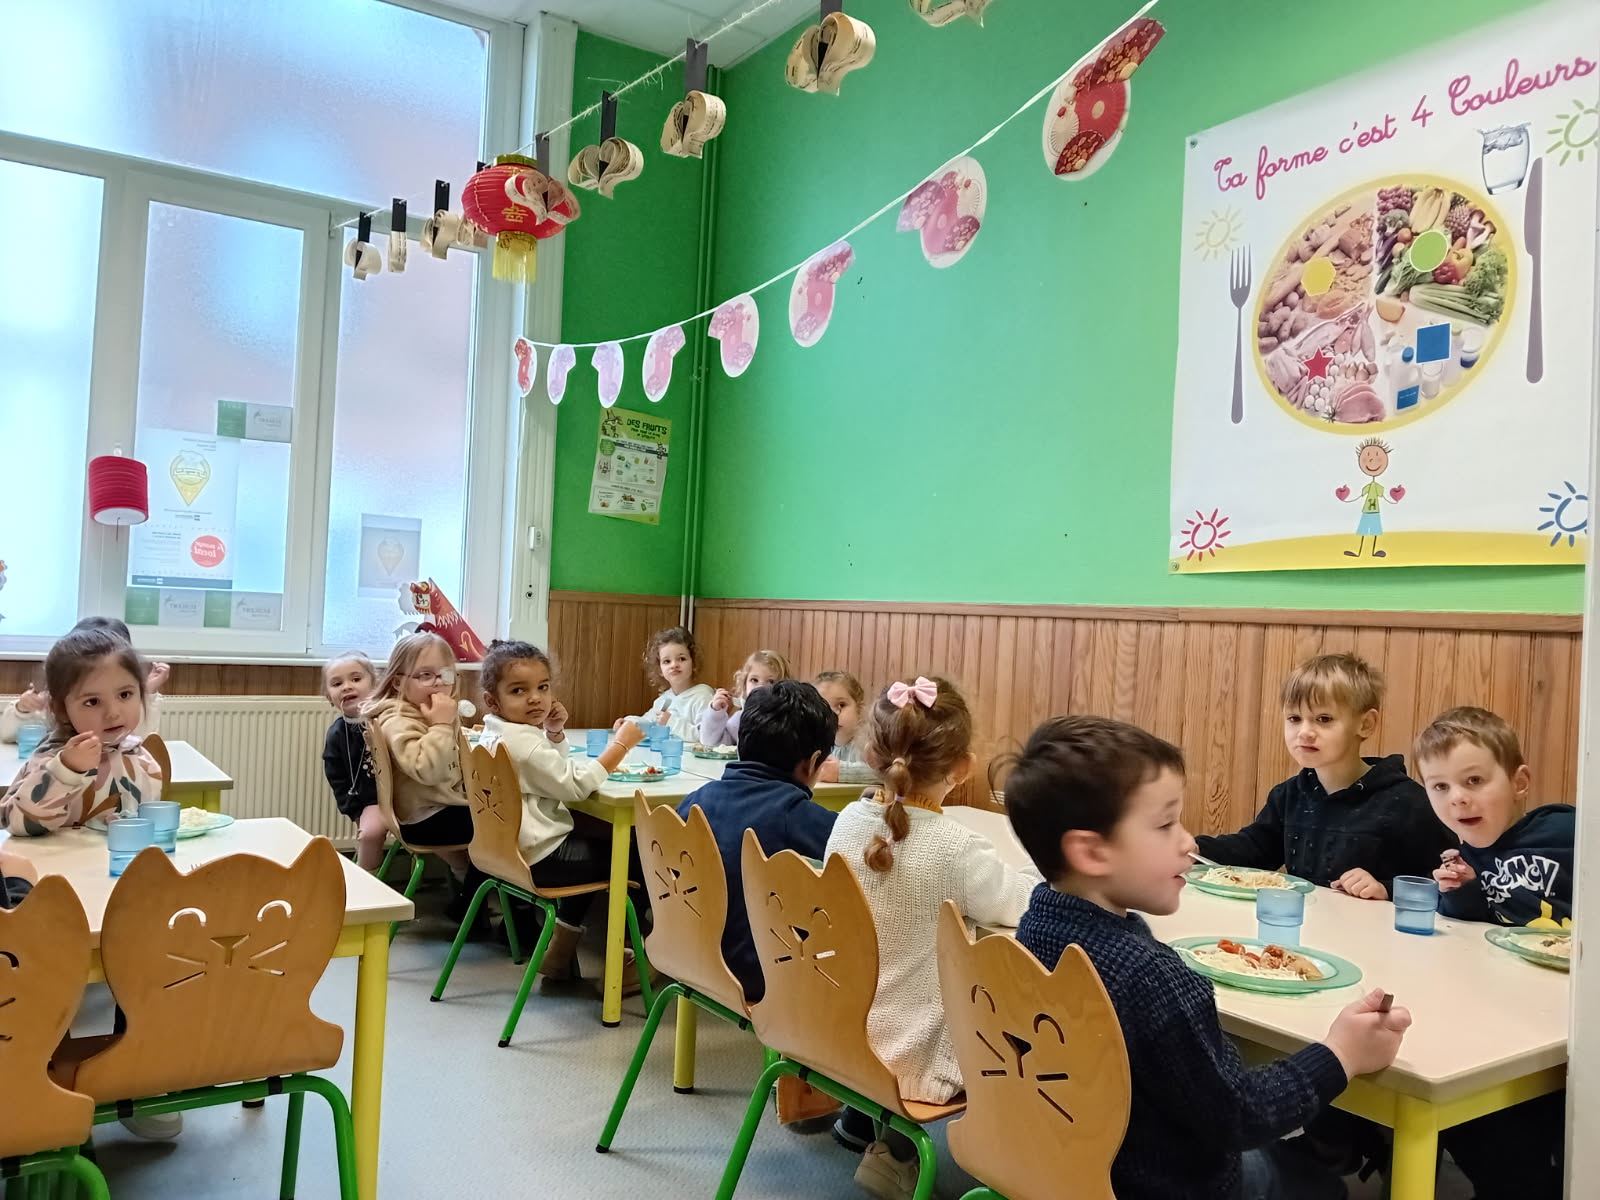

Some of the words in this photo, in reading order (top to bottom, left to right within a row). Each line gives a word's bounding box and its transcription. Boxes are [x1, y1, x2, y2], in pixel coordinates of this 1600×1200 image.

[1214, 157, 1247, 191] Ta
[1255, 146, 1329, 200] forme
[1339, 113, 1398, 154] c'est
[1411, 94, 1434, 128] 4
[1448, 57, 1597, 117] Couleurs
[626, 418, 641, 428] DES
[642, 422, 667, 435] FRUITS
